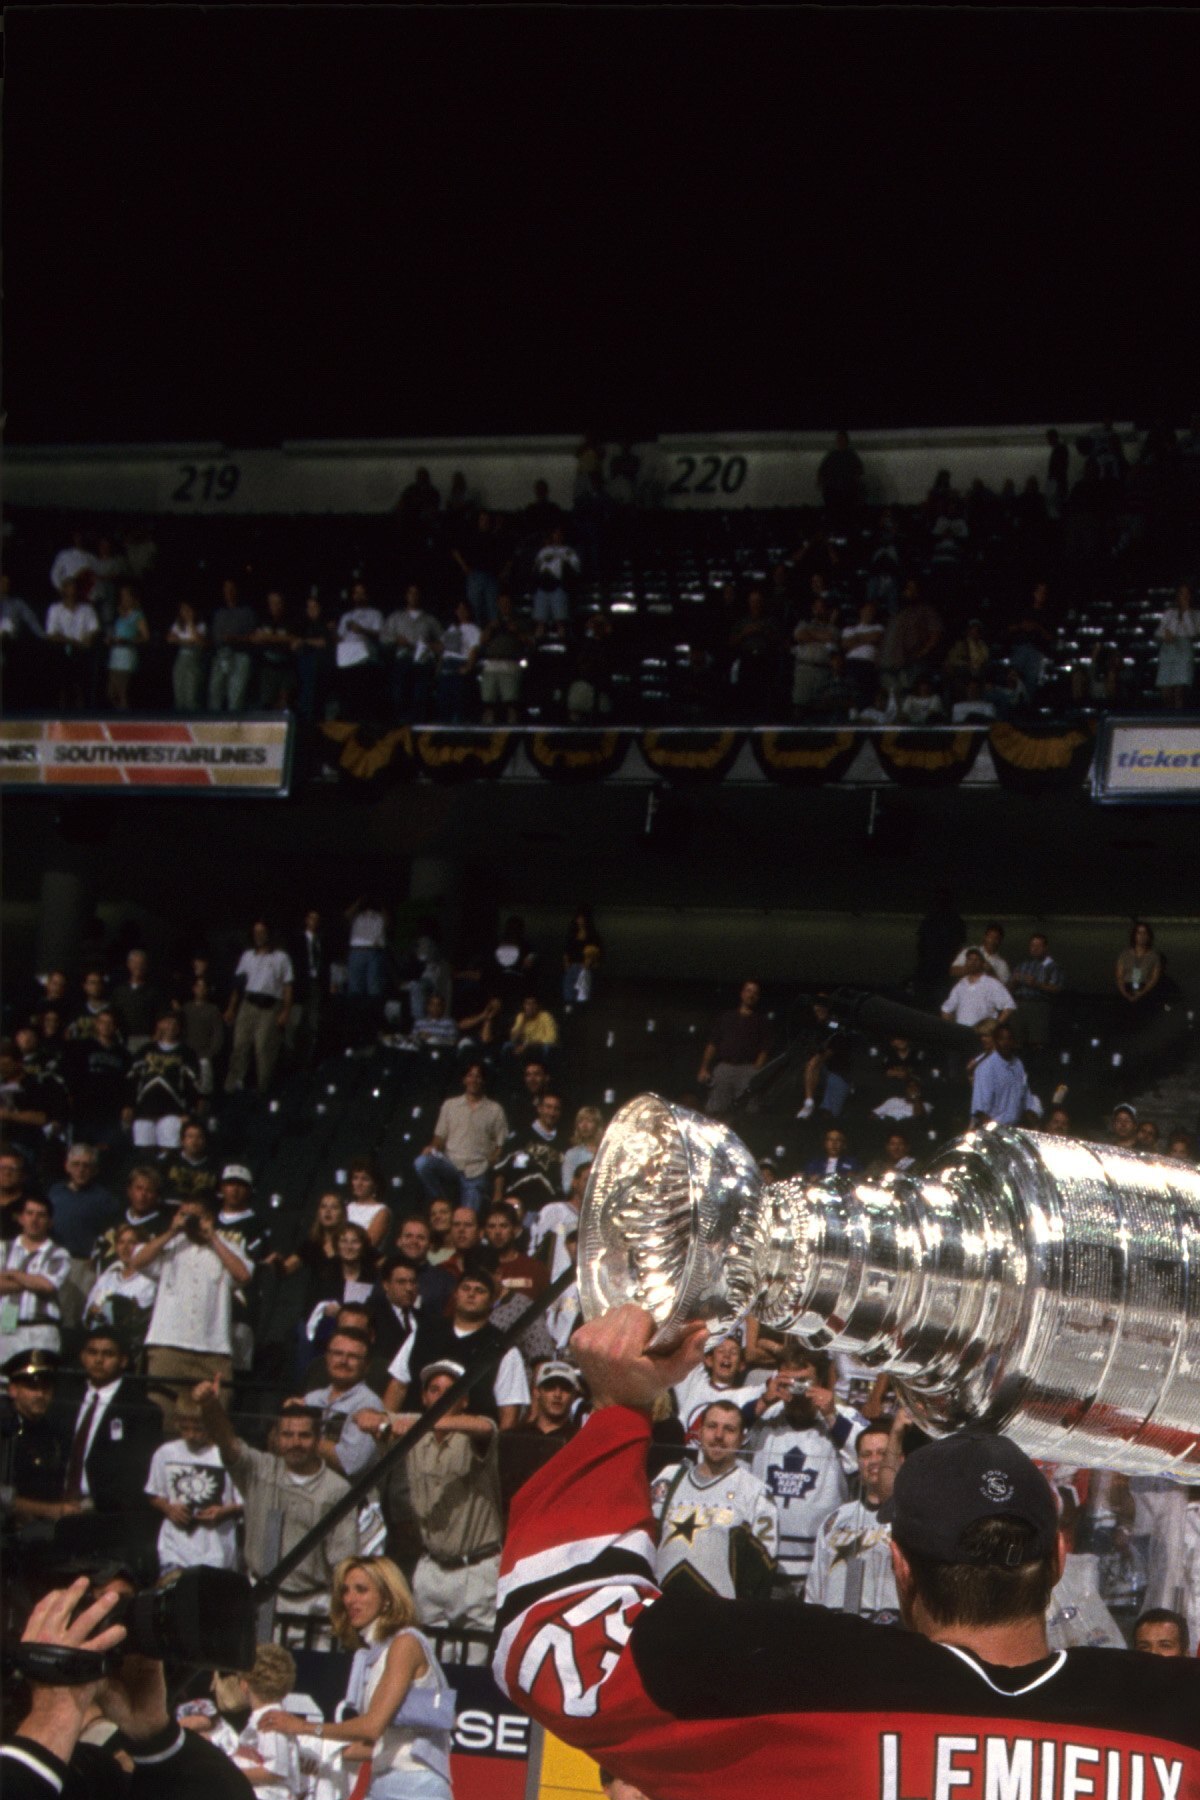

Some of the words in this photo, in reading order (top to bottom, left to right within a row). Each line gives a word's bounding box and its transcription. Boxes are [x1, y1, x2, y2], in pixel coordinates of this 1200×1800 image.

[172, 464, 241, 503] 219
[669, 455, 748, 494] 220
[453, 1709, 530, 1754] SE
